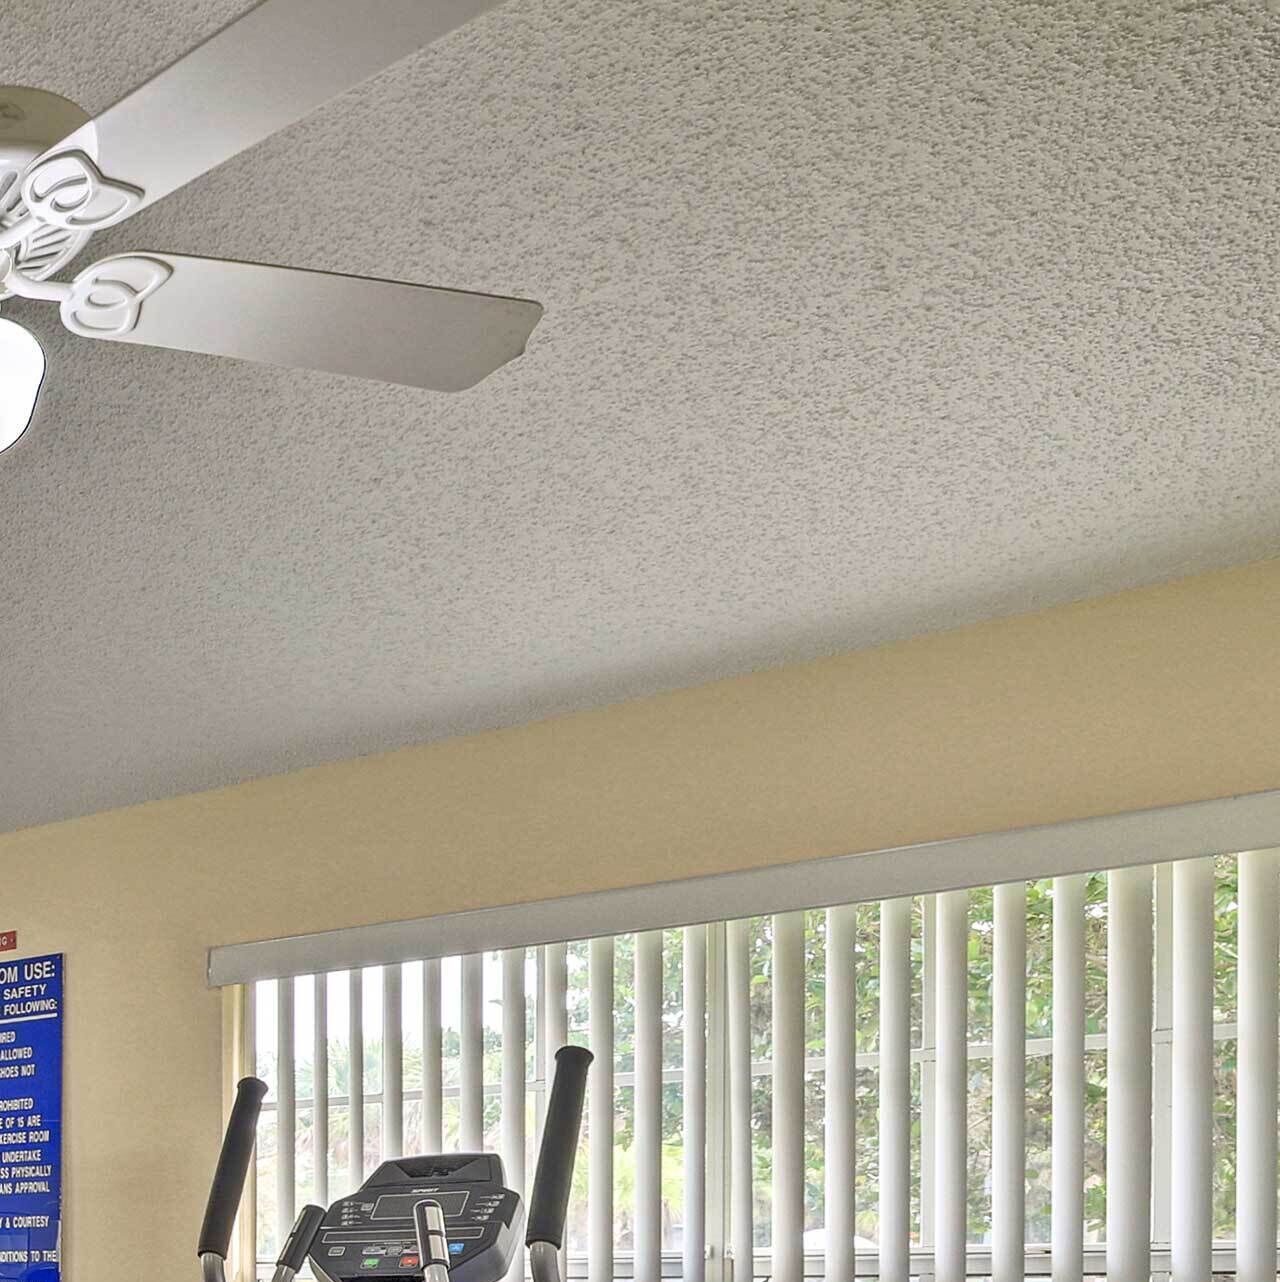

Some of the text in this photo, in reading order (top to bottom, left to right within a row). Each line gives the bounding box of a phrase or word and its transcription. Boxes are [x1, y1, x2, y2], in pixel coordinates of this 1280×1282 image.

[24, 961, 55, 980] USE:
[4, 984, 47, 999] SAFETY
[4, 999, 57, 1015] FOLLOWING:
[0, 1047, 32, 1062] ALLOWED
[21, 1064, 35, 1076] NOT
[5, 1117, 15, 1127] OF
[27, 1115, 41, 1126] ARE
[29, 1130, 49, 1142] ROOM
[3, 1149, 41, 1162] UNDERTAKE
[11, 1165, 51, 1177] PHYSICALLY
[15, 1181, 50, 1193] APPROVAL
[13, 1216, 49, 1228] COURTESY
[31, 1251, 40, 1261] TO
[43, 1250, 56, 1261] THE
